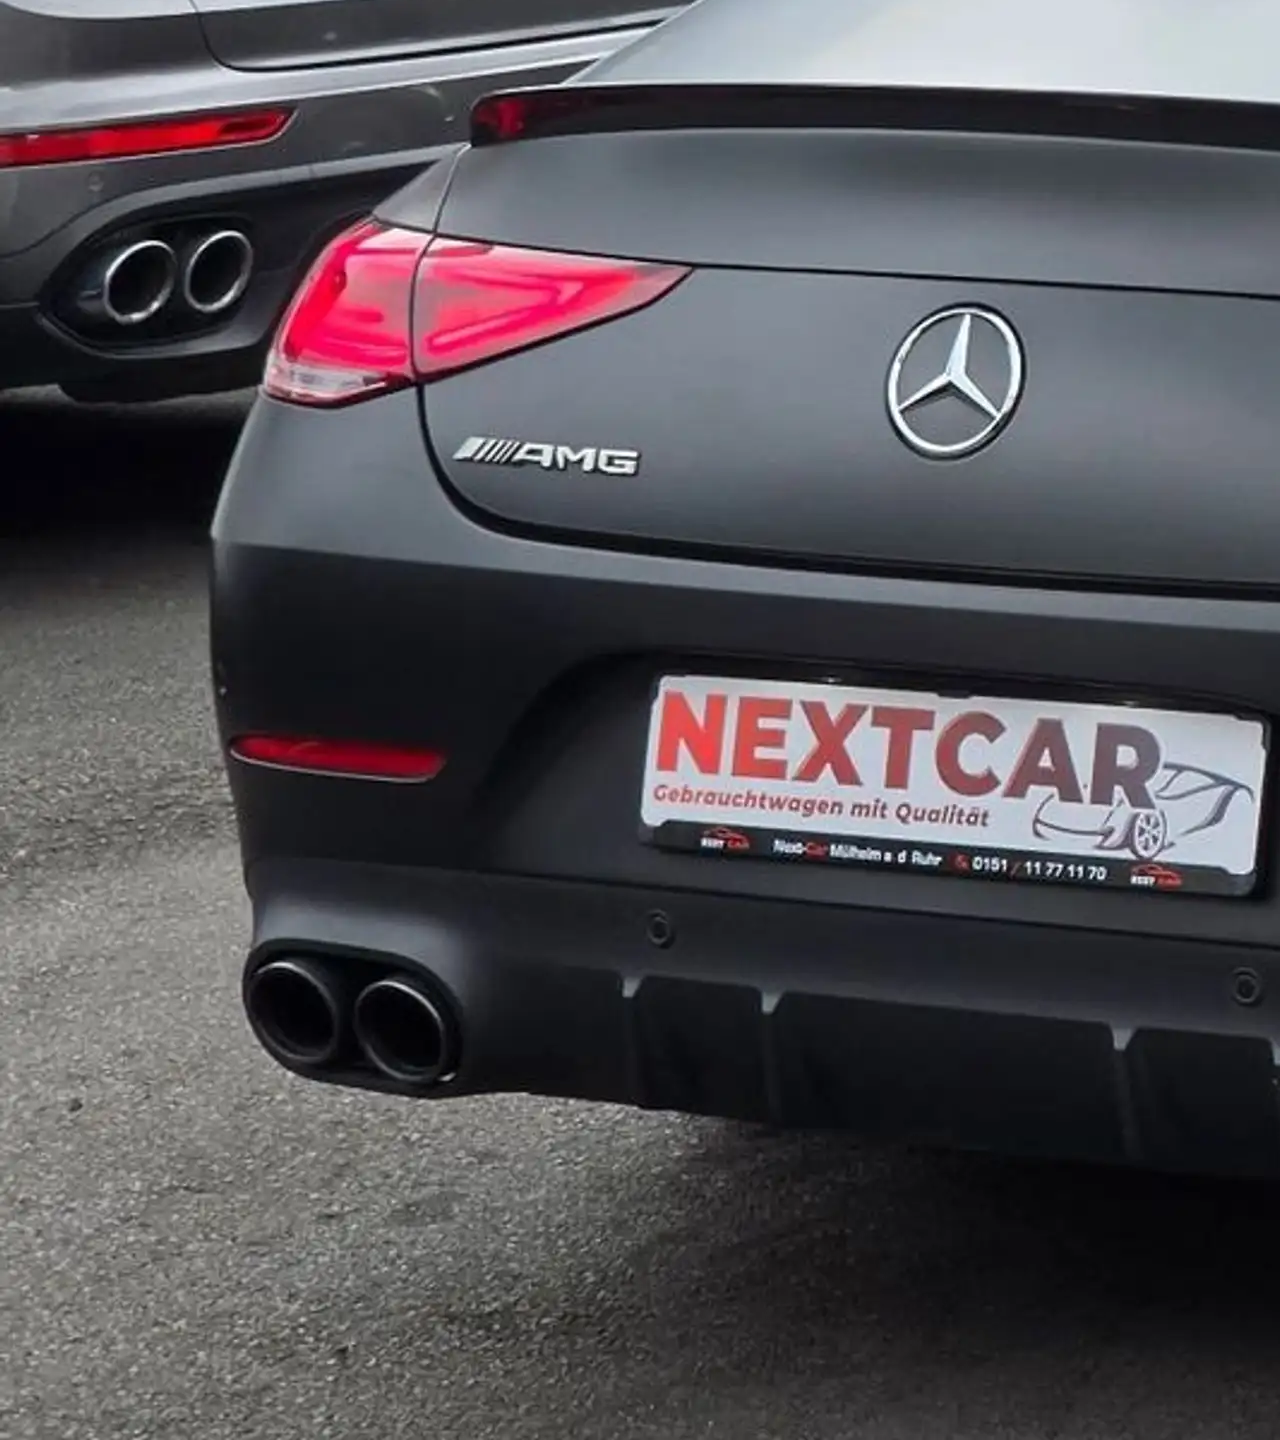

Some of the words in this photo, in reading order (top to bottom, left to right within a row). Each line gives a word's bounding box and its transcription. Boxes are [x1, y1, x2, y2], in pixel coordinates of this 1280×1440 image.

[656, 691, 1161, 810] NEXTCAR
[653, 784, 843, 818] Gebrauchtwagen
[850, 798, 889, 820] mit
[895, 802, 991, 828] Qualität
[972, 856, 1008, 873] 0151
